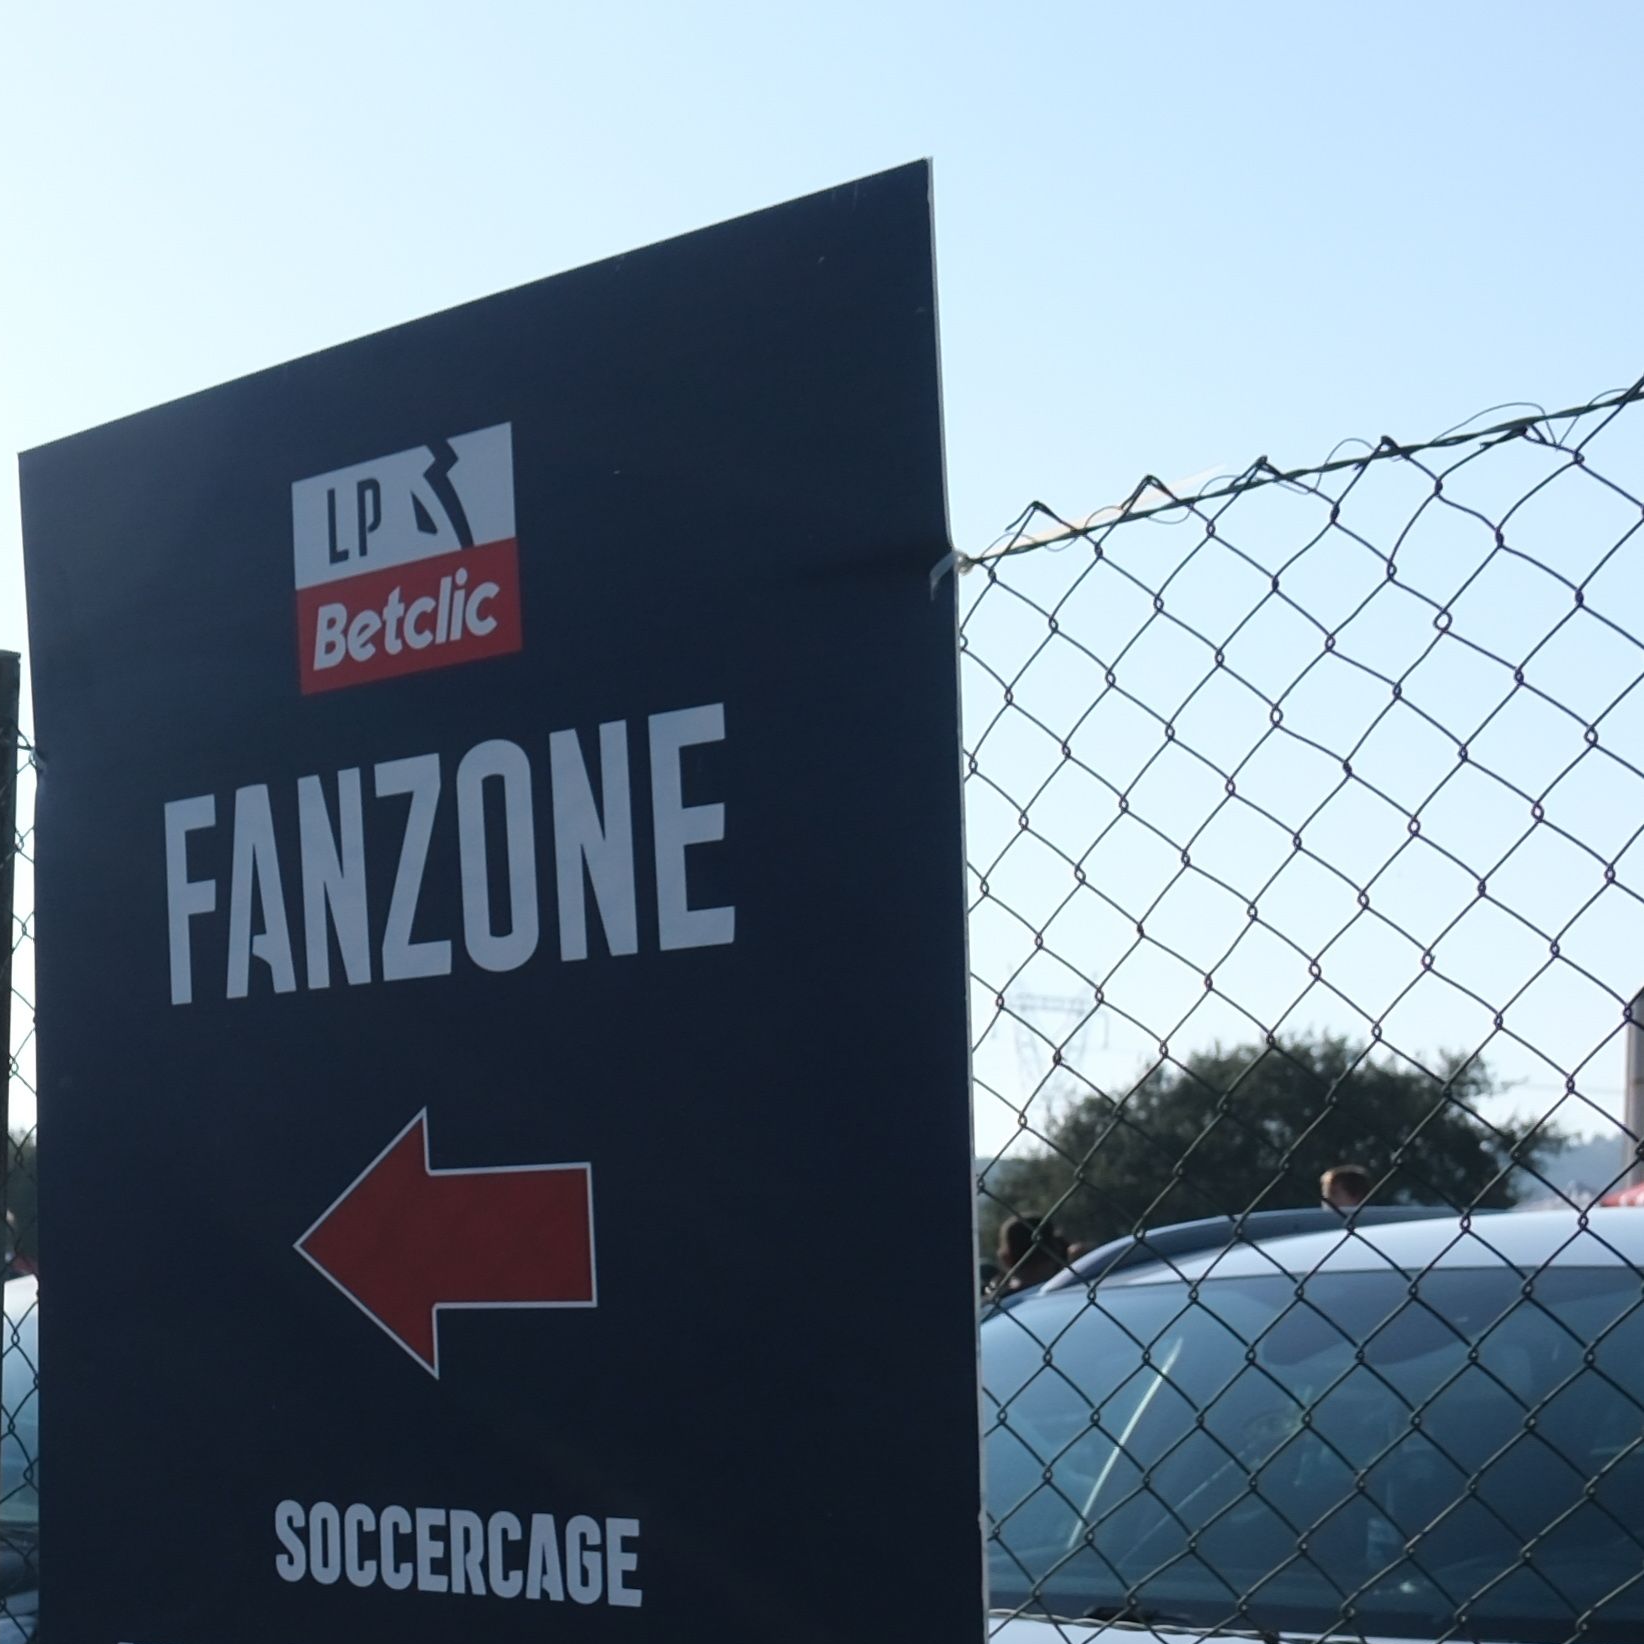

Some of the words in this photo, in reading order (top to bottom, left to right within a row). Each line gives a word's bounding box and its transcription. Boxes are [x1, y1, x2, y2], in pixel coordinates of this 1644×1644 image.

[313, 567, 501, 672] Betclic
[164, 702, 736, 1005] FANZONE
[274, 1499, 643, 1607] SOCCERCAGE
